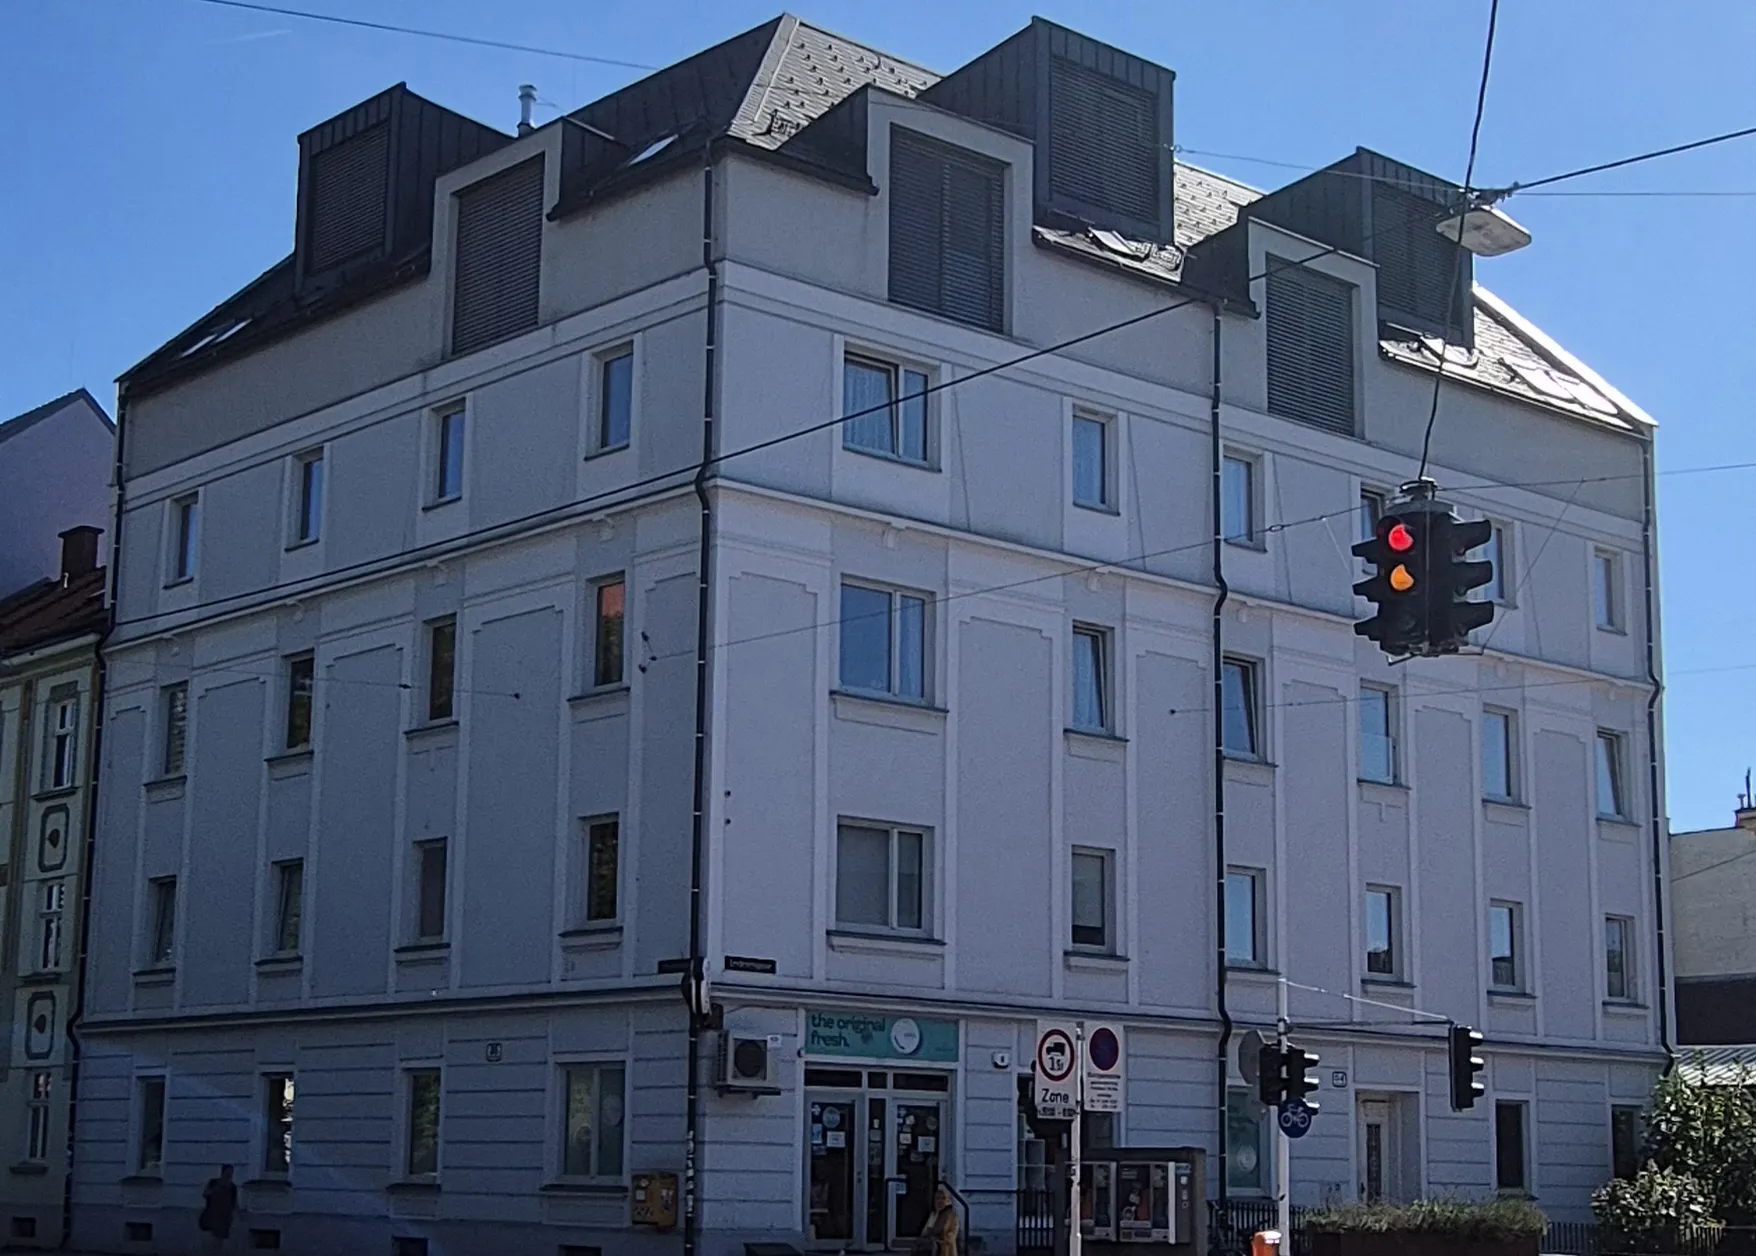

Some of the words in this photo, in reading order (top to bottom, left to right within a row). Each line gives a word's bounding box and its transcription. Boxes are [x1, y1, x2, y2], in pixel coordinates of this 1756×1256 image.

[811, 1012, 835, 1029] the
[836, 1015, 886, 1034] original
[1041, 1088, 1070, 1104] Zone
